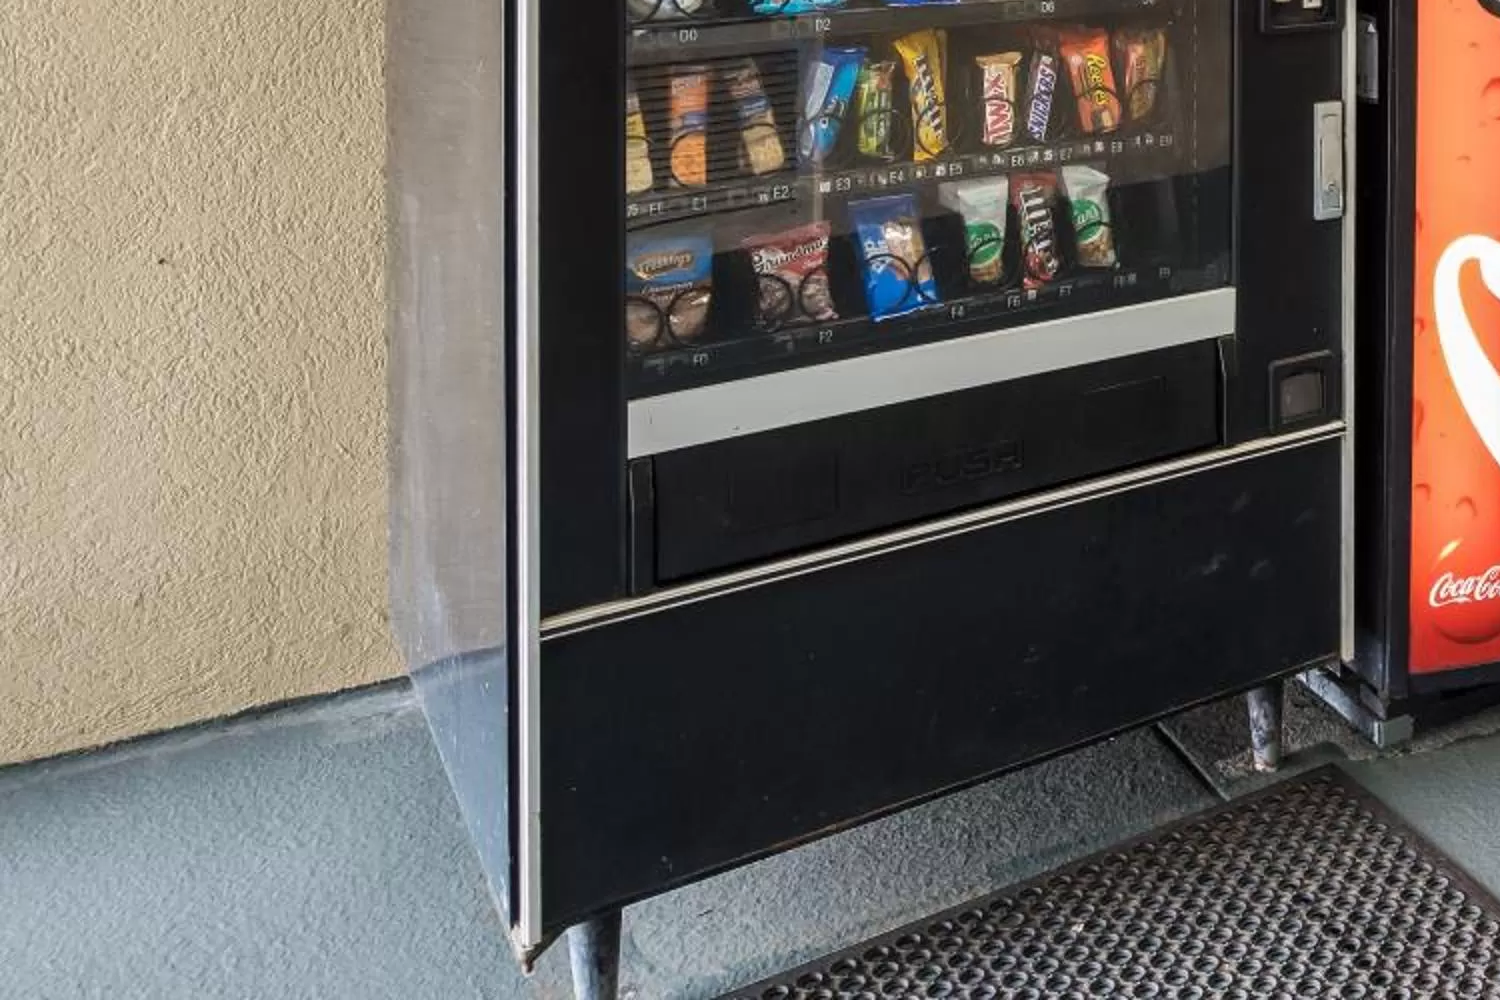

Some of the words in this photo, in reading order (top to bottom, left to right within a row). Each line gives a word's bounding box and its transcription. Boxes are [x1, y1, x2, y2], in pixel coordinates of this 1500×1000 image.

[815, 18, 831, 32] D2
[680, 29, 698, 42] D0
[1027, 54, 1057, 142] SNICKERS
[889, 170, 904, 183] E4
[949, 163, 963, 176] E5
[835, 177, 851, 191] E3
[773, 186, 789, 200] E2
[950, 304, 965, 319] F4
[818, 330, 833, 343] F2
